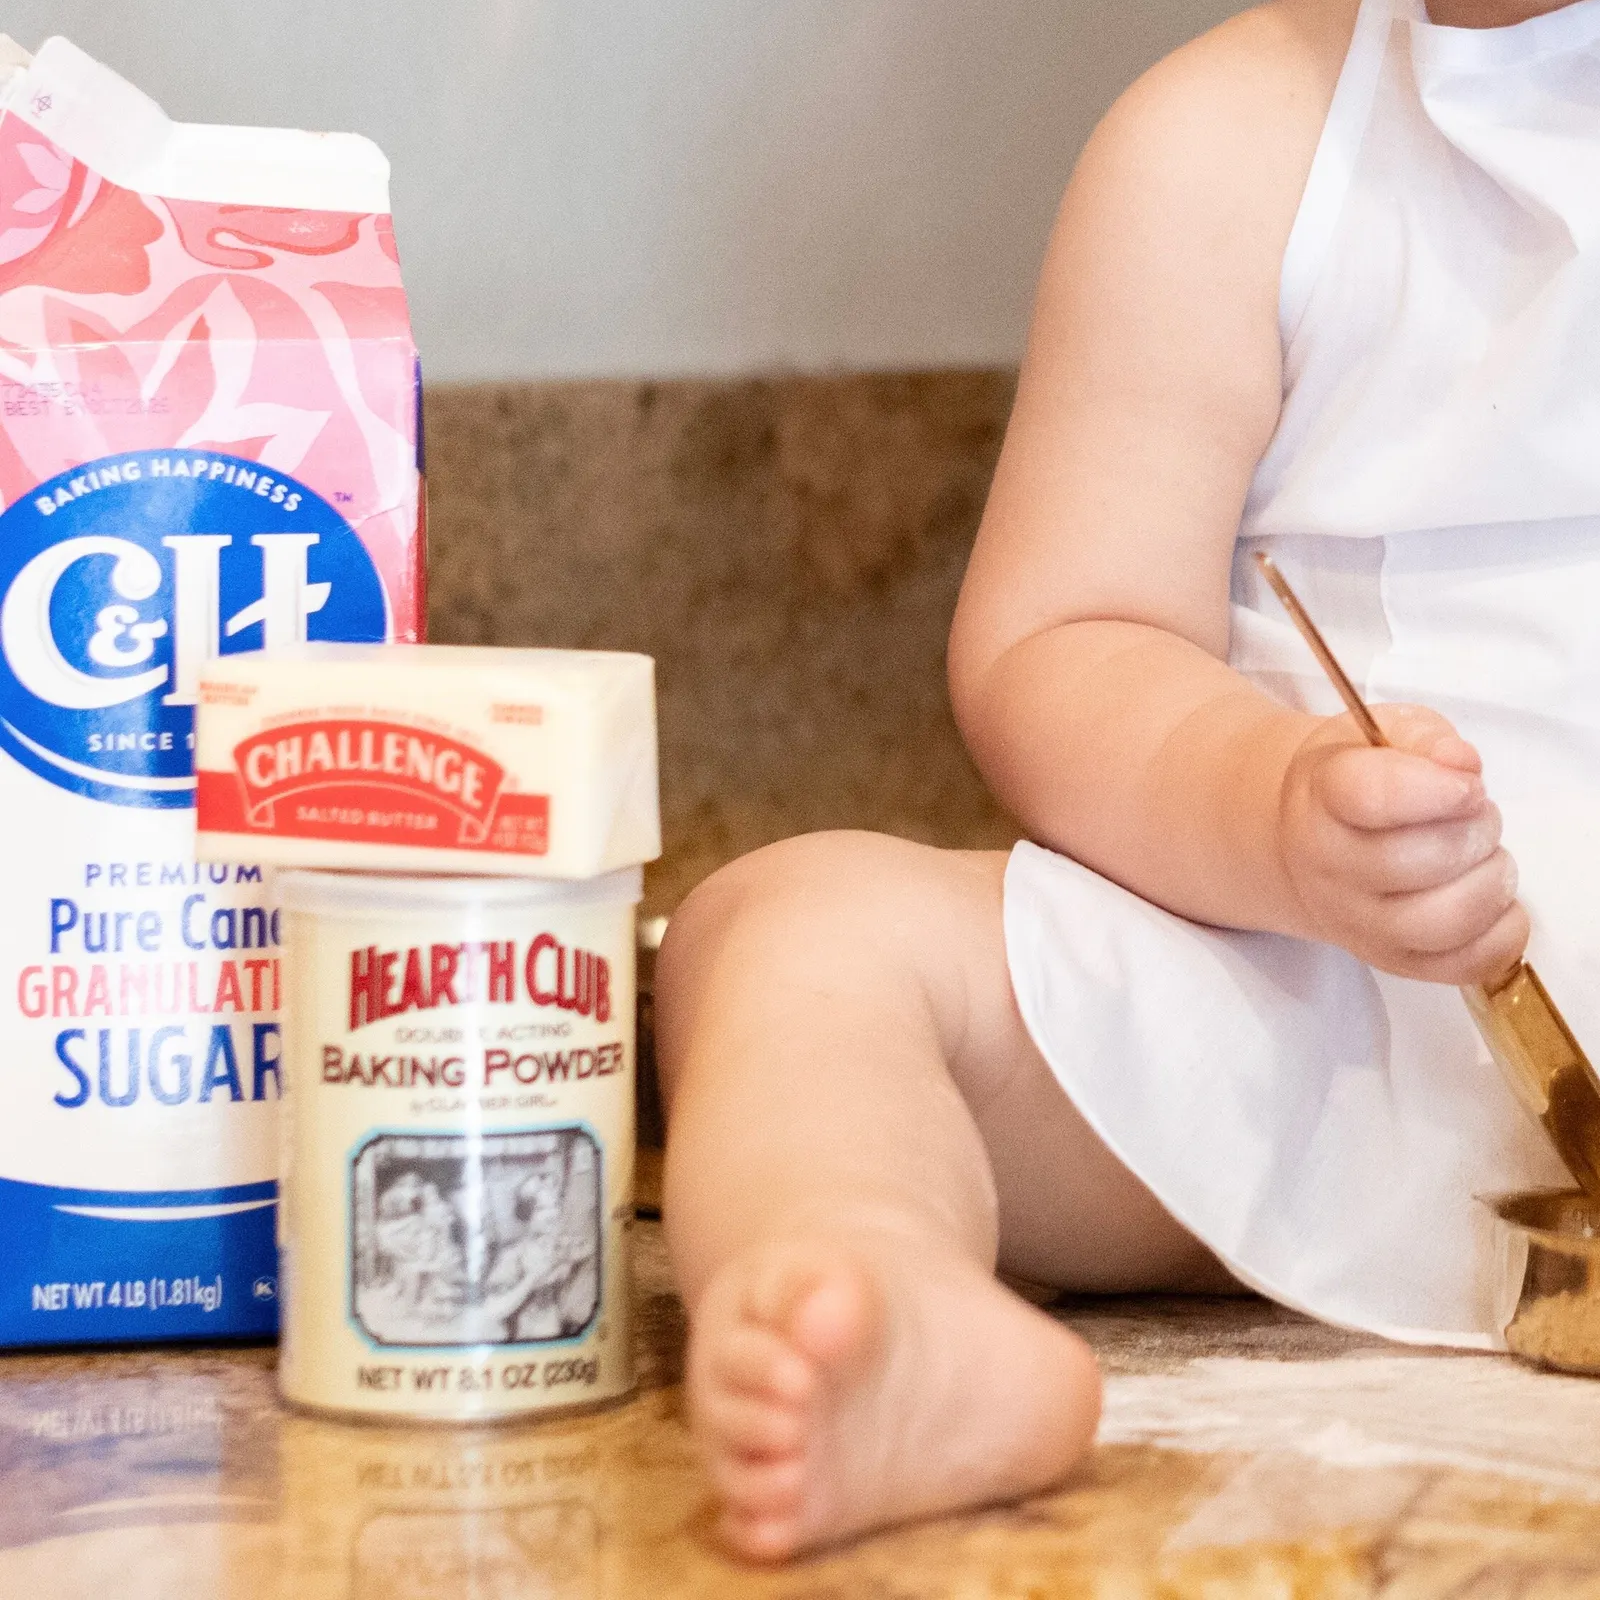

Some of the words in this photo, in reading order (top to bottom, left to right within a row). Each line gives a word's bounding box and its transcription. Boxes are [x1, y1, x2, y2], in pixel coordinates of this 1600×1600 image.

[35, 461, 141, 516] BAKING
[151, 458, 302, 512] HAPPINESS
[1, 532, 332, 710] C&H
[88, 732, 173, 752] SINCE
[245, 729, 487, 809] CHALLENGE
[296, 806, 364, 824] SALTED
[366, 810, 439, 830] BUTTER
[85, 862, 263, 888] PREMIUM
[50, 897, 163, 954] Pure
[348, 941, 517, 1032] HEARTH
[524, 932, 612, 1024] CLUB
[396, 1026, 488, 1043] DOUBE
[496, 1023, 573, 1041] ACTING
[54, 1022, 284, 1109] SUGAR
[320, 1044, 467, 1088] BAKING
[484, 1040, 625, 1086] POWDER
[31, 1282, 71, 1311] NET
[73, 1281, 106, 1310] WT
[107, 1281, 124, 1308] 4
[125, 1279, 148, 1308] LB
[150, 1274, 222, 1313] (1.81kg)
[357, 1364, 404, 1391] NET
[412, 1365, 453, 1392] WT
[501, 1363, 537, 1390] OZ
